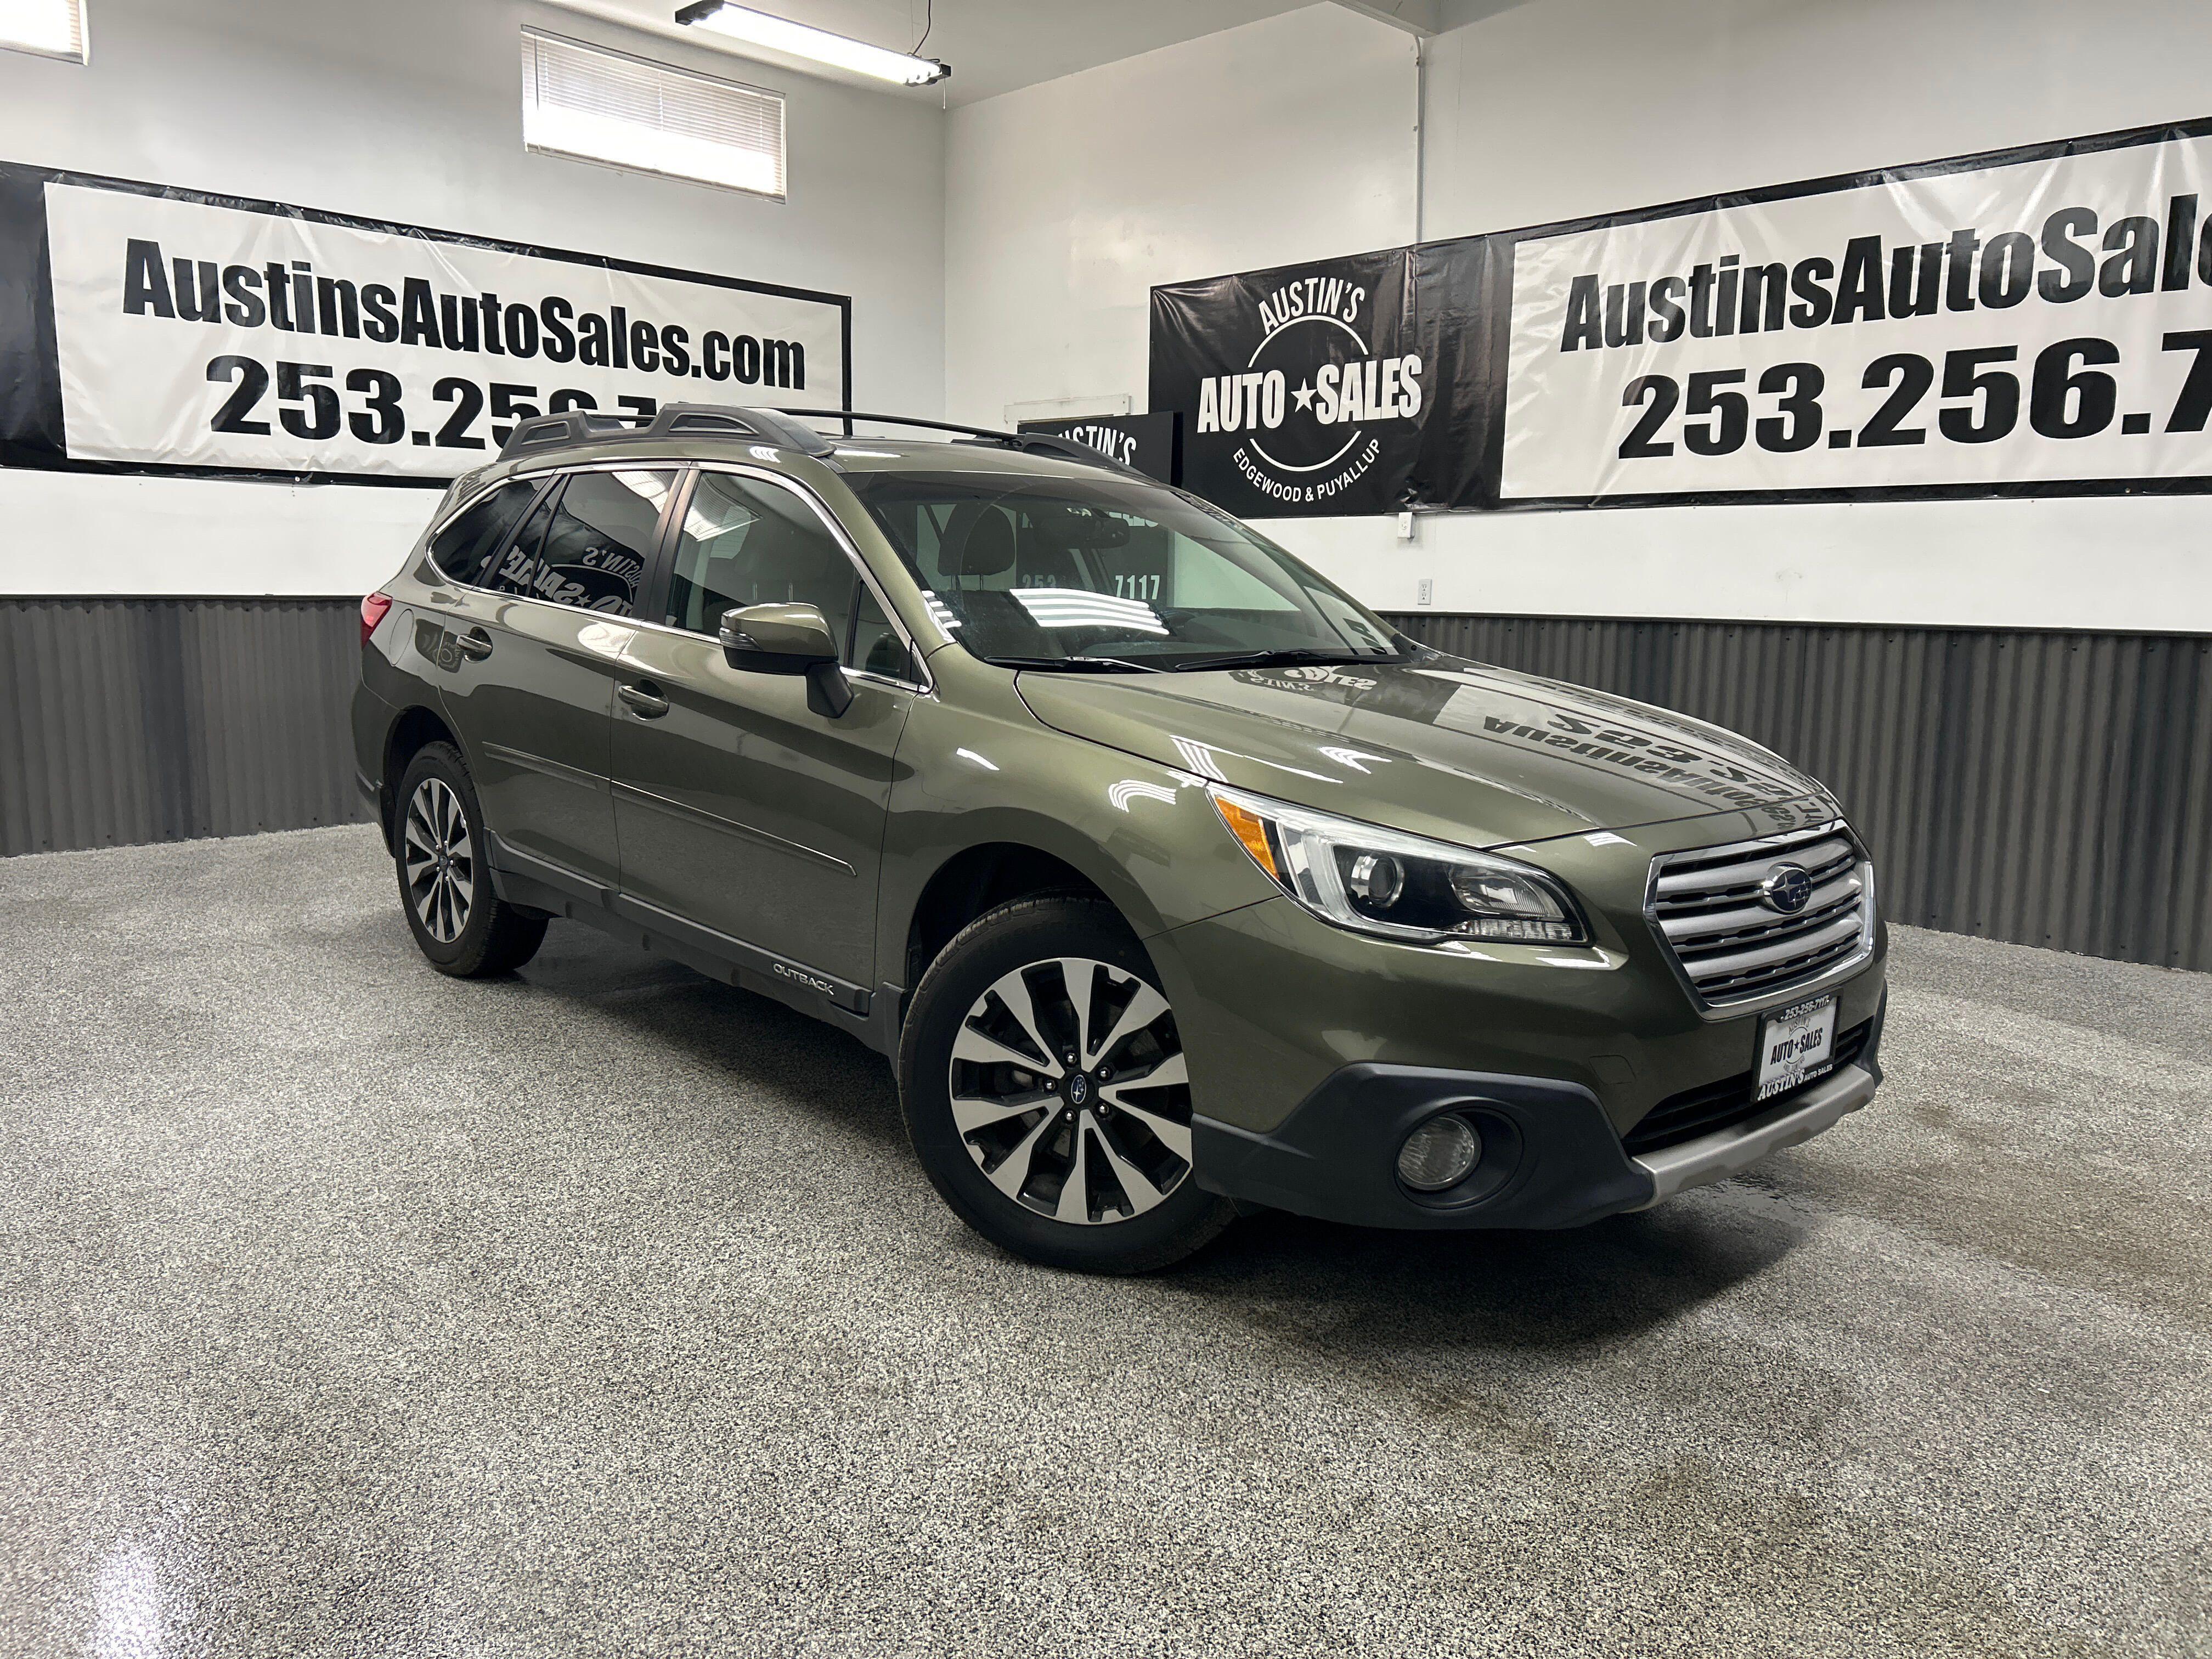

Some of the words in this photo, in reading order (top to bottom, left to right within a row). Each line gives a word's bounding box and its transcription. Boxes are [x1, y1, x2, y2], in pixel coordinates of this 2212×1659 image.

[123, 238, 805, 391] AustinsAutoSales.com
[1258, 277, 1365, 335] AUSTIN'S
[206, 355, 657, 450] 253.25
[1197, 370, 1285, 433] AUTO
[1316, 354, 1423, 425] SALES
[1618, 329, 2212, 459] 253.256.7
[1058, 425, 1137, 466] STIN'S
[1233, 448, 1301, 502] EDGEWOOD
[1305, 487, 1314, 502] &
[1317, 439, 1380, 500] PUYALLUP
[1115, 574, 1160, 600] 7117
[773, 963, 834, 996] OUTBACK
[1785, 995, 1830, 1020] 253-256-7117
[1770, 1039, 1794, 1065] AUTO
[1799, 1027, 1823, 1054] SALES
[1757, 1068, 1805, 1101] AUSTIN'S
[1804, 1070, 1818, 1082] AUTO
[1818, 1064, 1833, 1076] SALES
